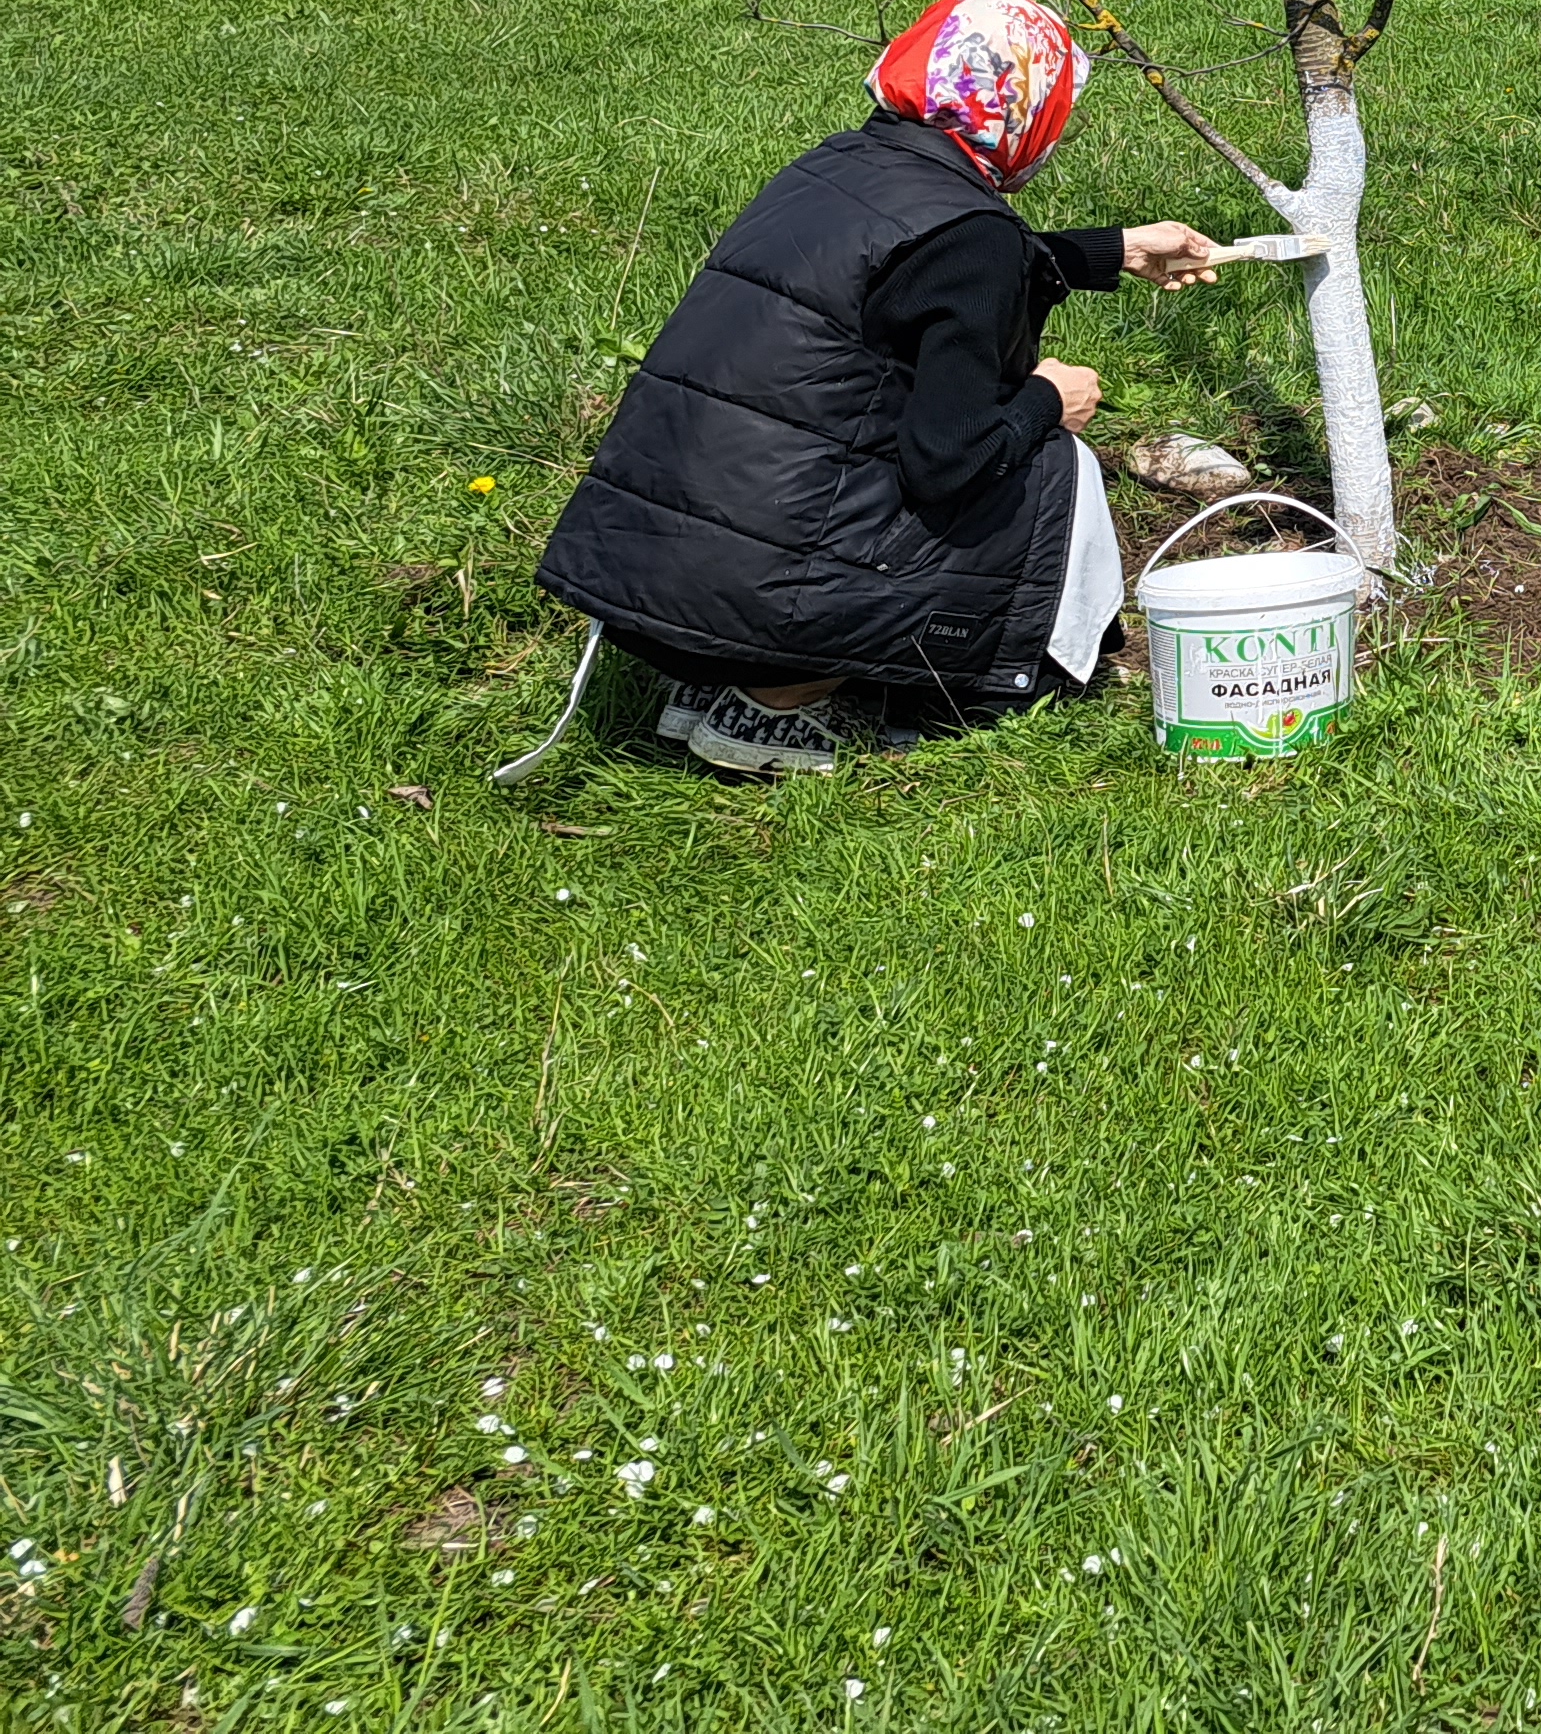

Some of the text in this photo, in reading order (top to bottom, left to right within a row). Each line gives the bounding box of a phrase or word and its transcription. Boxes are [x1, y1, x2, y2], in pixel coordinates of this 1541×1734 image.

[1202, 622, 1337, 664] KONTI
[1209, 667, 1255, 679] КРАСКА
[1211, 668, 1332, 698] ФАСАДНАЯ
